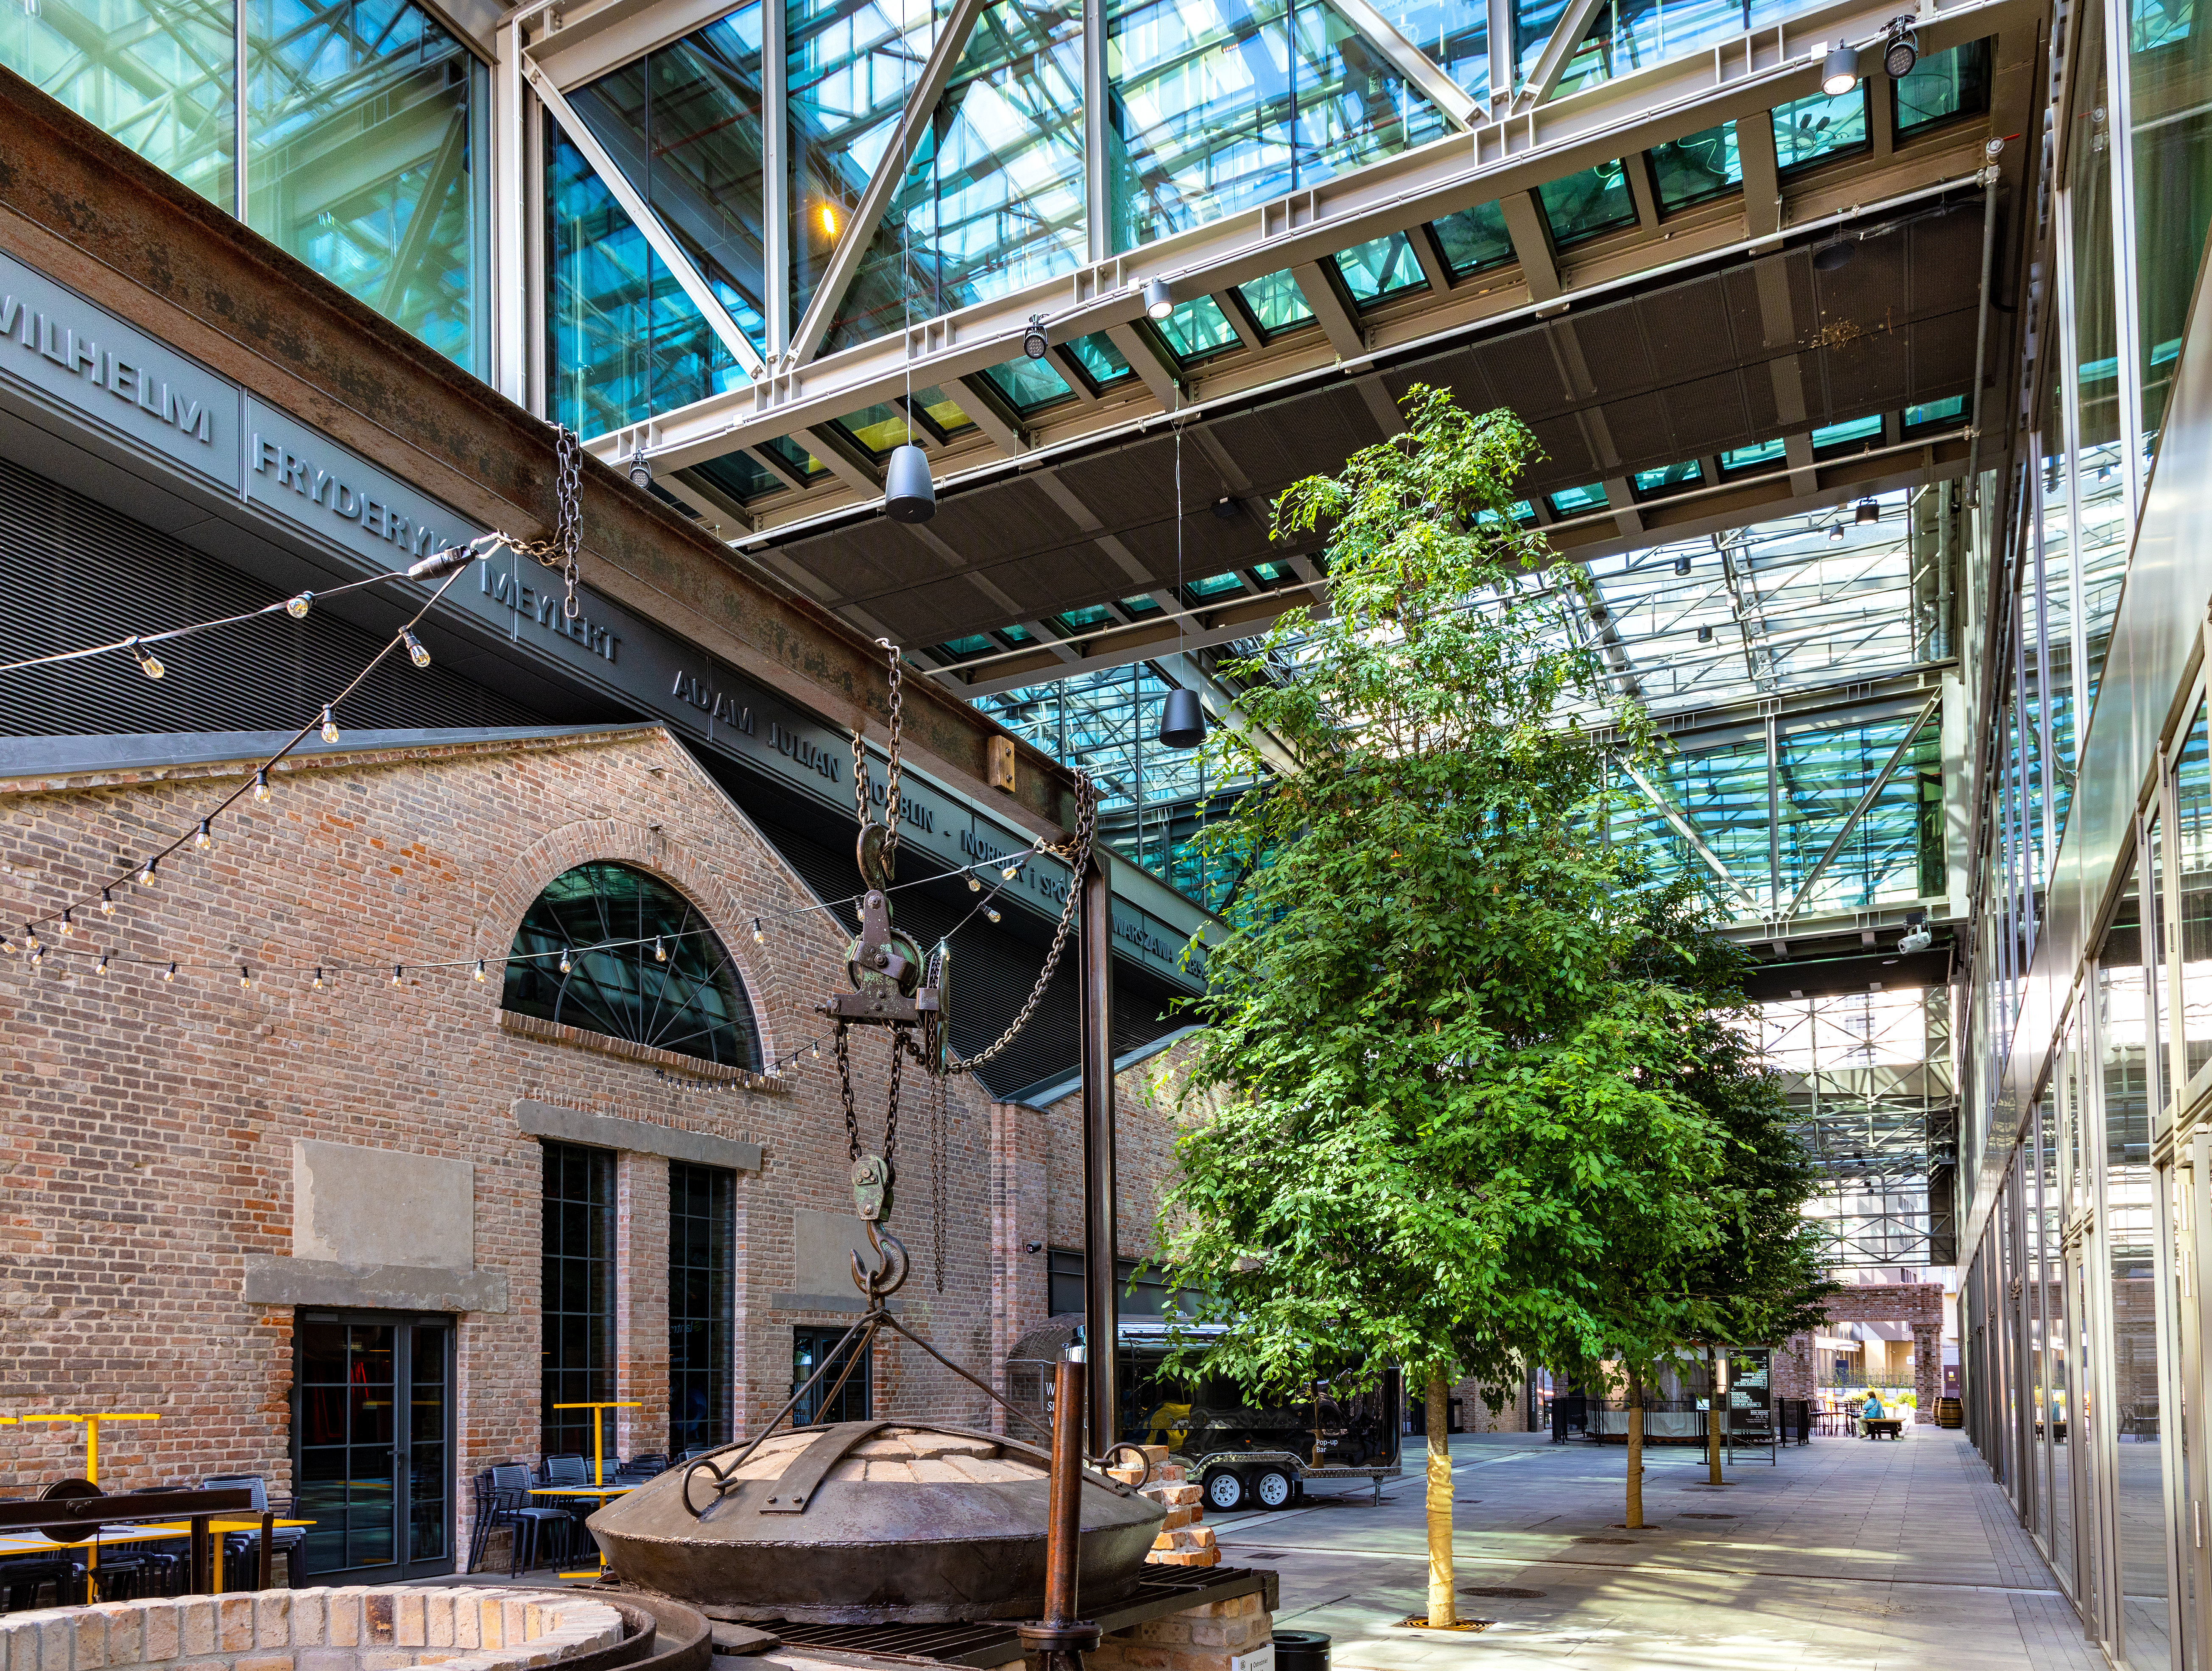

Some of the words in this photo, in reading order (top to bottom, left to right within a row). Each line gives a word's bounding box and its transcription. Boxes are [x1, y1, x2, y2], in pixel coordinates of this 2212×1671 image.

[482, 561, 621, 661] MEYLERT
[673, 671, 753, 735] ADAM
[769, 723, 841, 783] JULIAN
[861, 772, 934, 833] NOBLIN
[1112, 913, 1173, 963] WARSZAWA
[1253, 1657, 1268, 1668] Ostrożnie!
